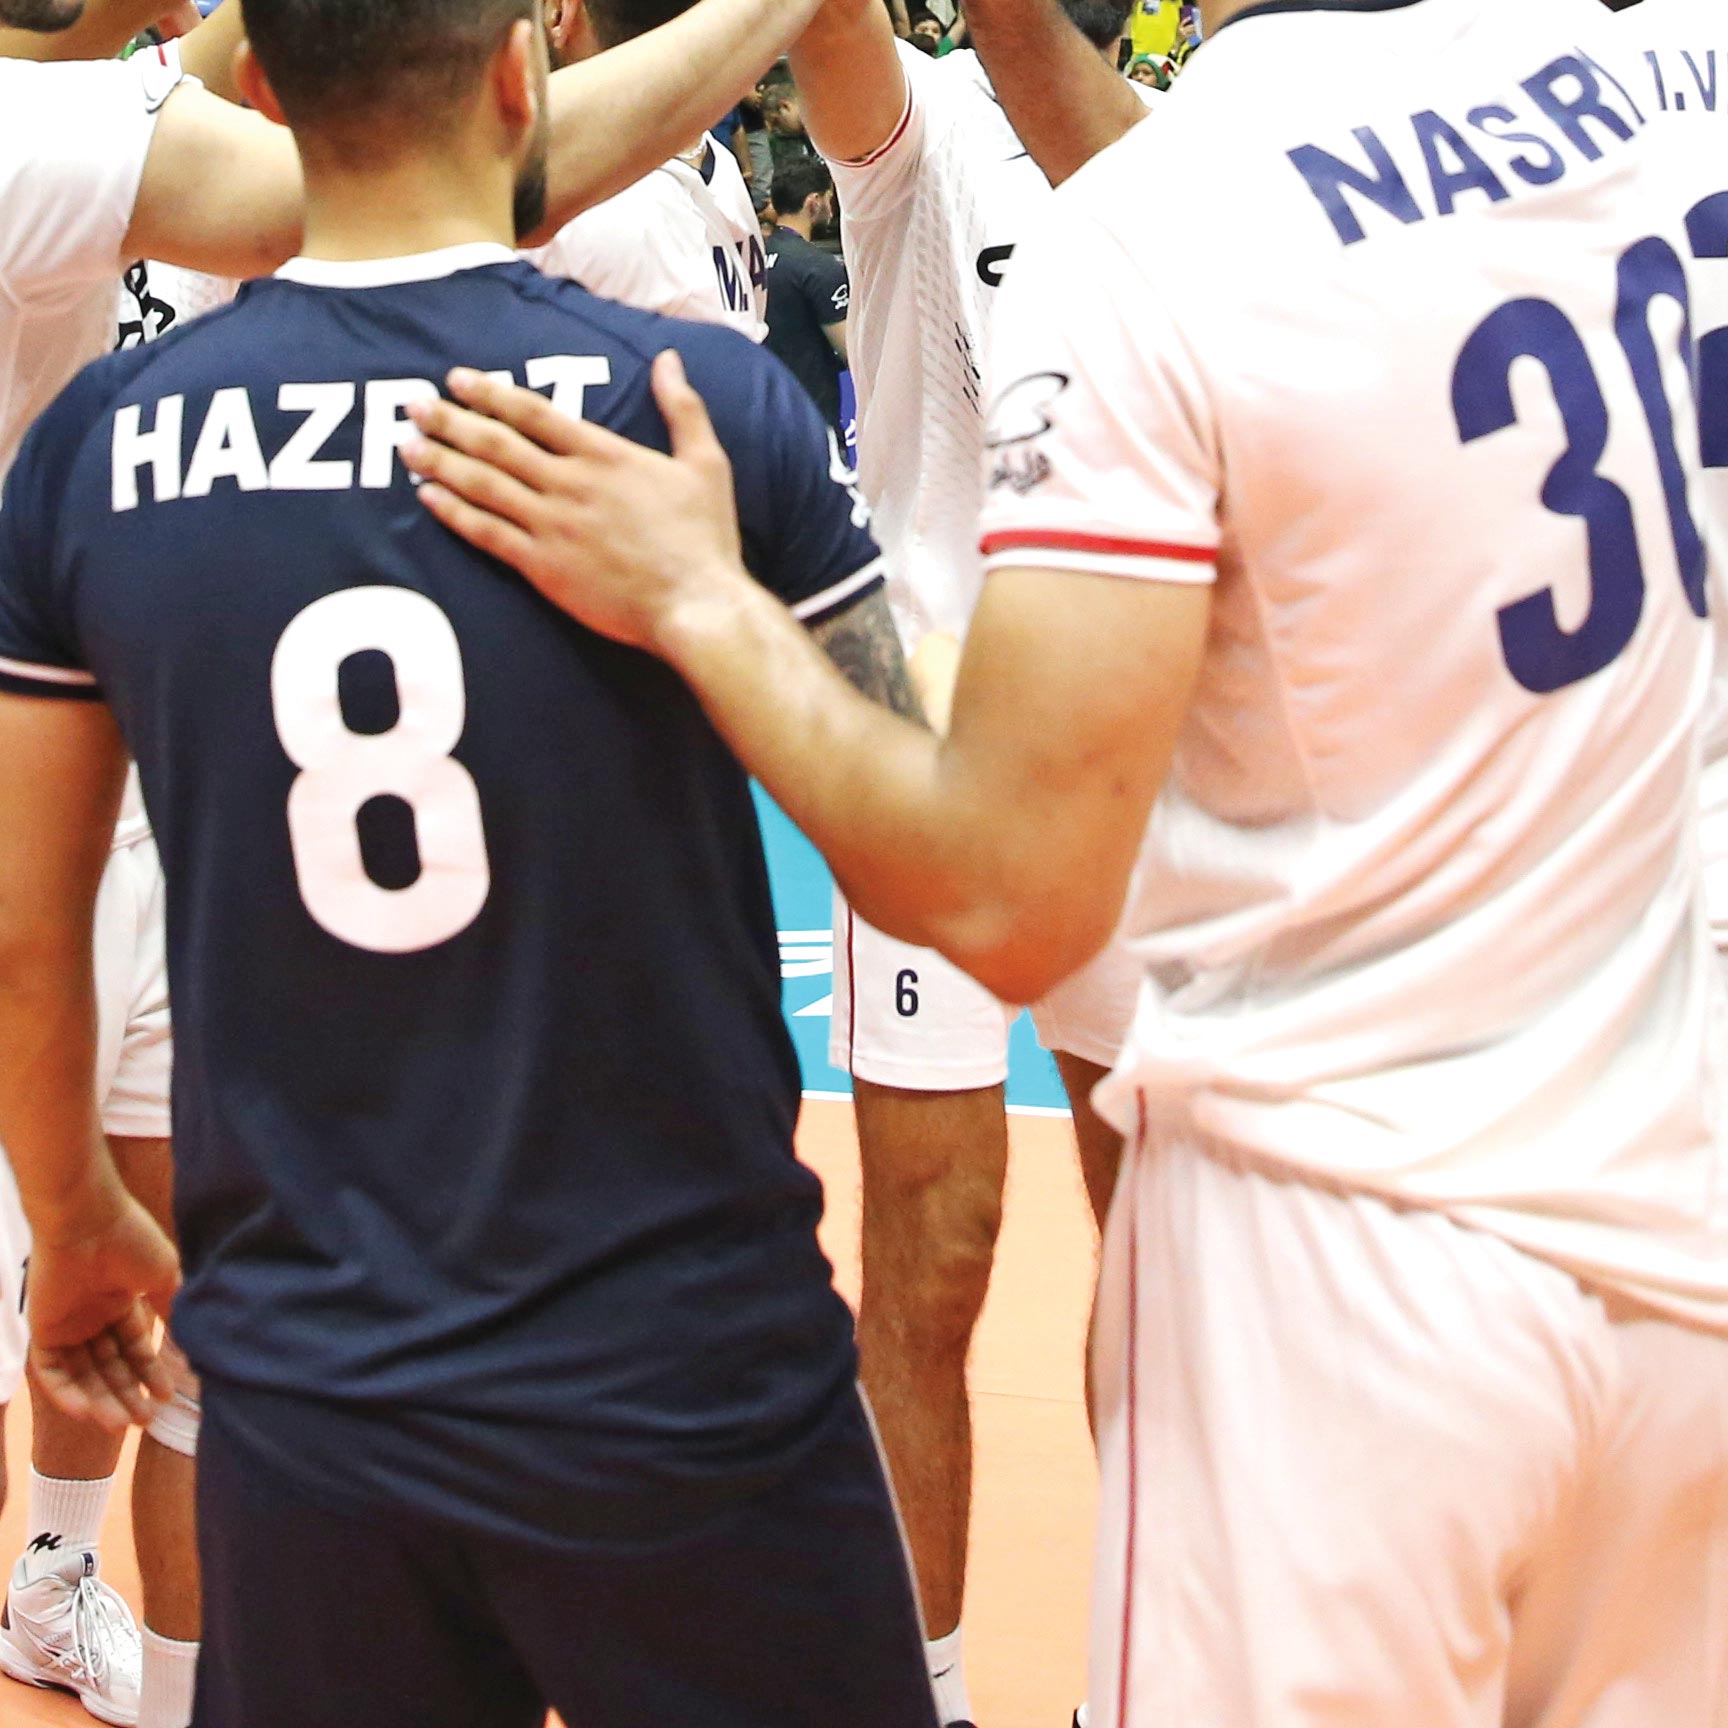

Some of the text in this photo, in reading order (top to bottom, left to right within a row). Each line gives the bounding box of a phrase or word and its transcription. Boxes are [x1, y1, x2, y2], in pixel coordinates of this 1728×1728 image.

[111, 354, 612, 513] HAZRT
[271, 584, 491, 954] 8
[895, 968, 920, 1018] 6
